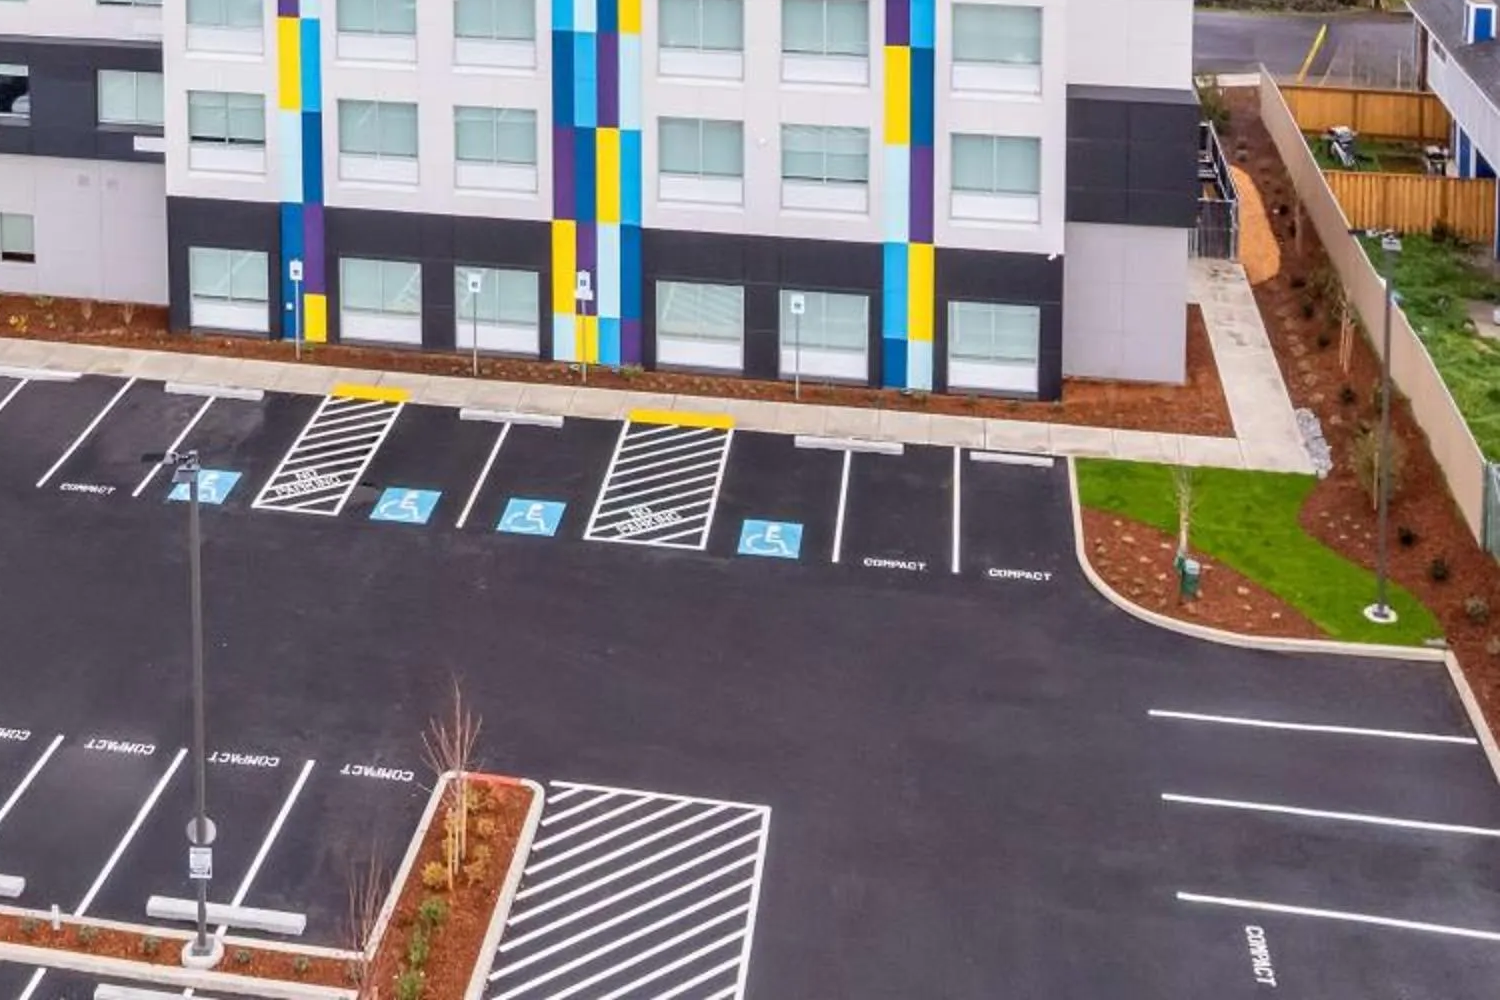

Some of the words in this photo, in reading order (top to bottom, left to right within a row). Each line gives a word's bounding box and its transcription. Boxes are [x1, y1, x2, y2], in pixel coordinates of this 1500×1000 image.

[863, 557, 927, 571] COMPACT
[988, 567, 1052, 581] COMPACT
[84, 738, 156, 756] COMPACT
[207, 751, 280, 767] COMPACT
[340, 763, 415, 782] COMPACT
[1245, 925, 1277, 987] COMPACT
